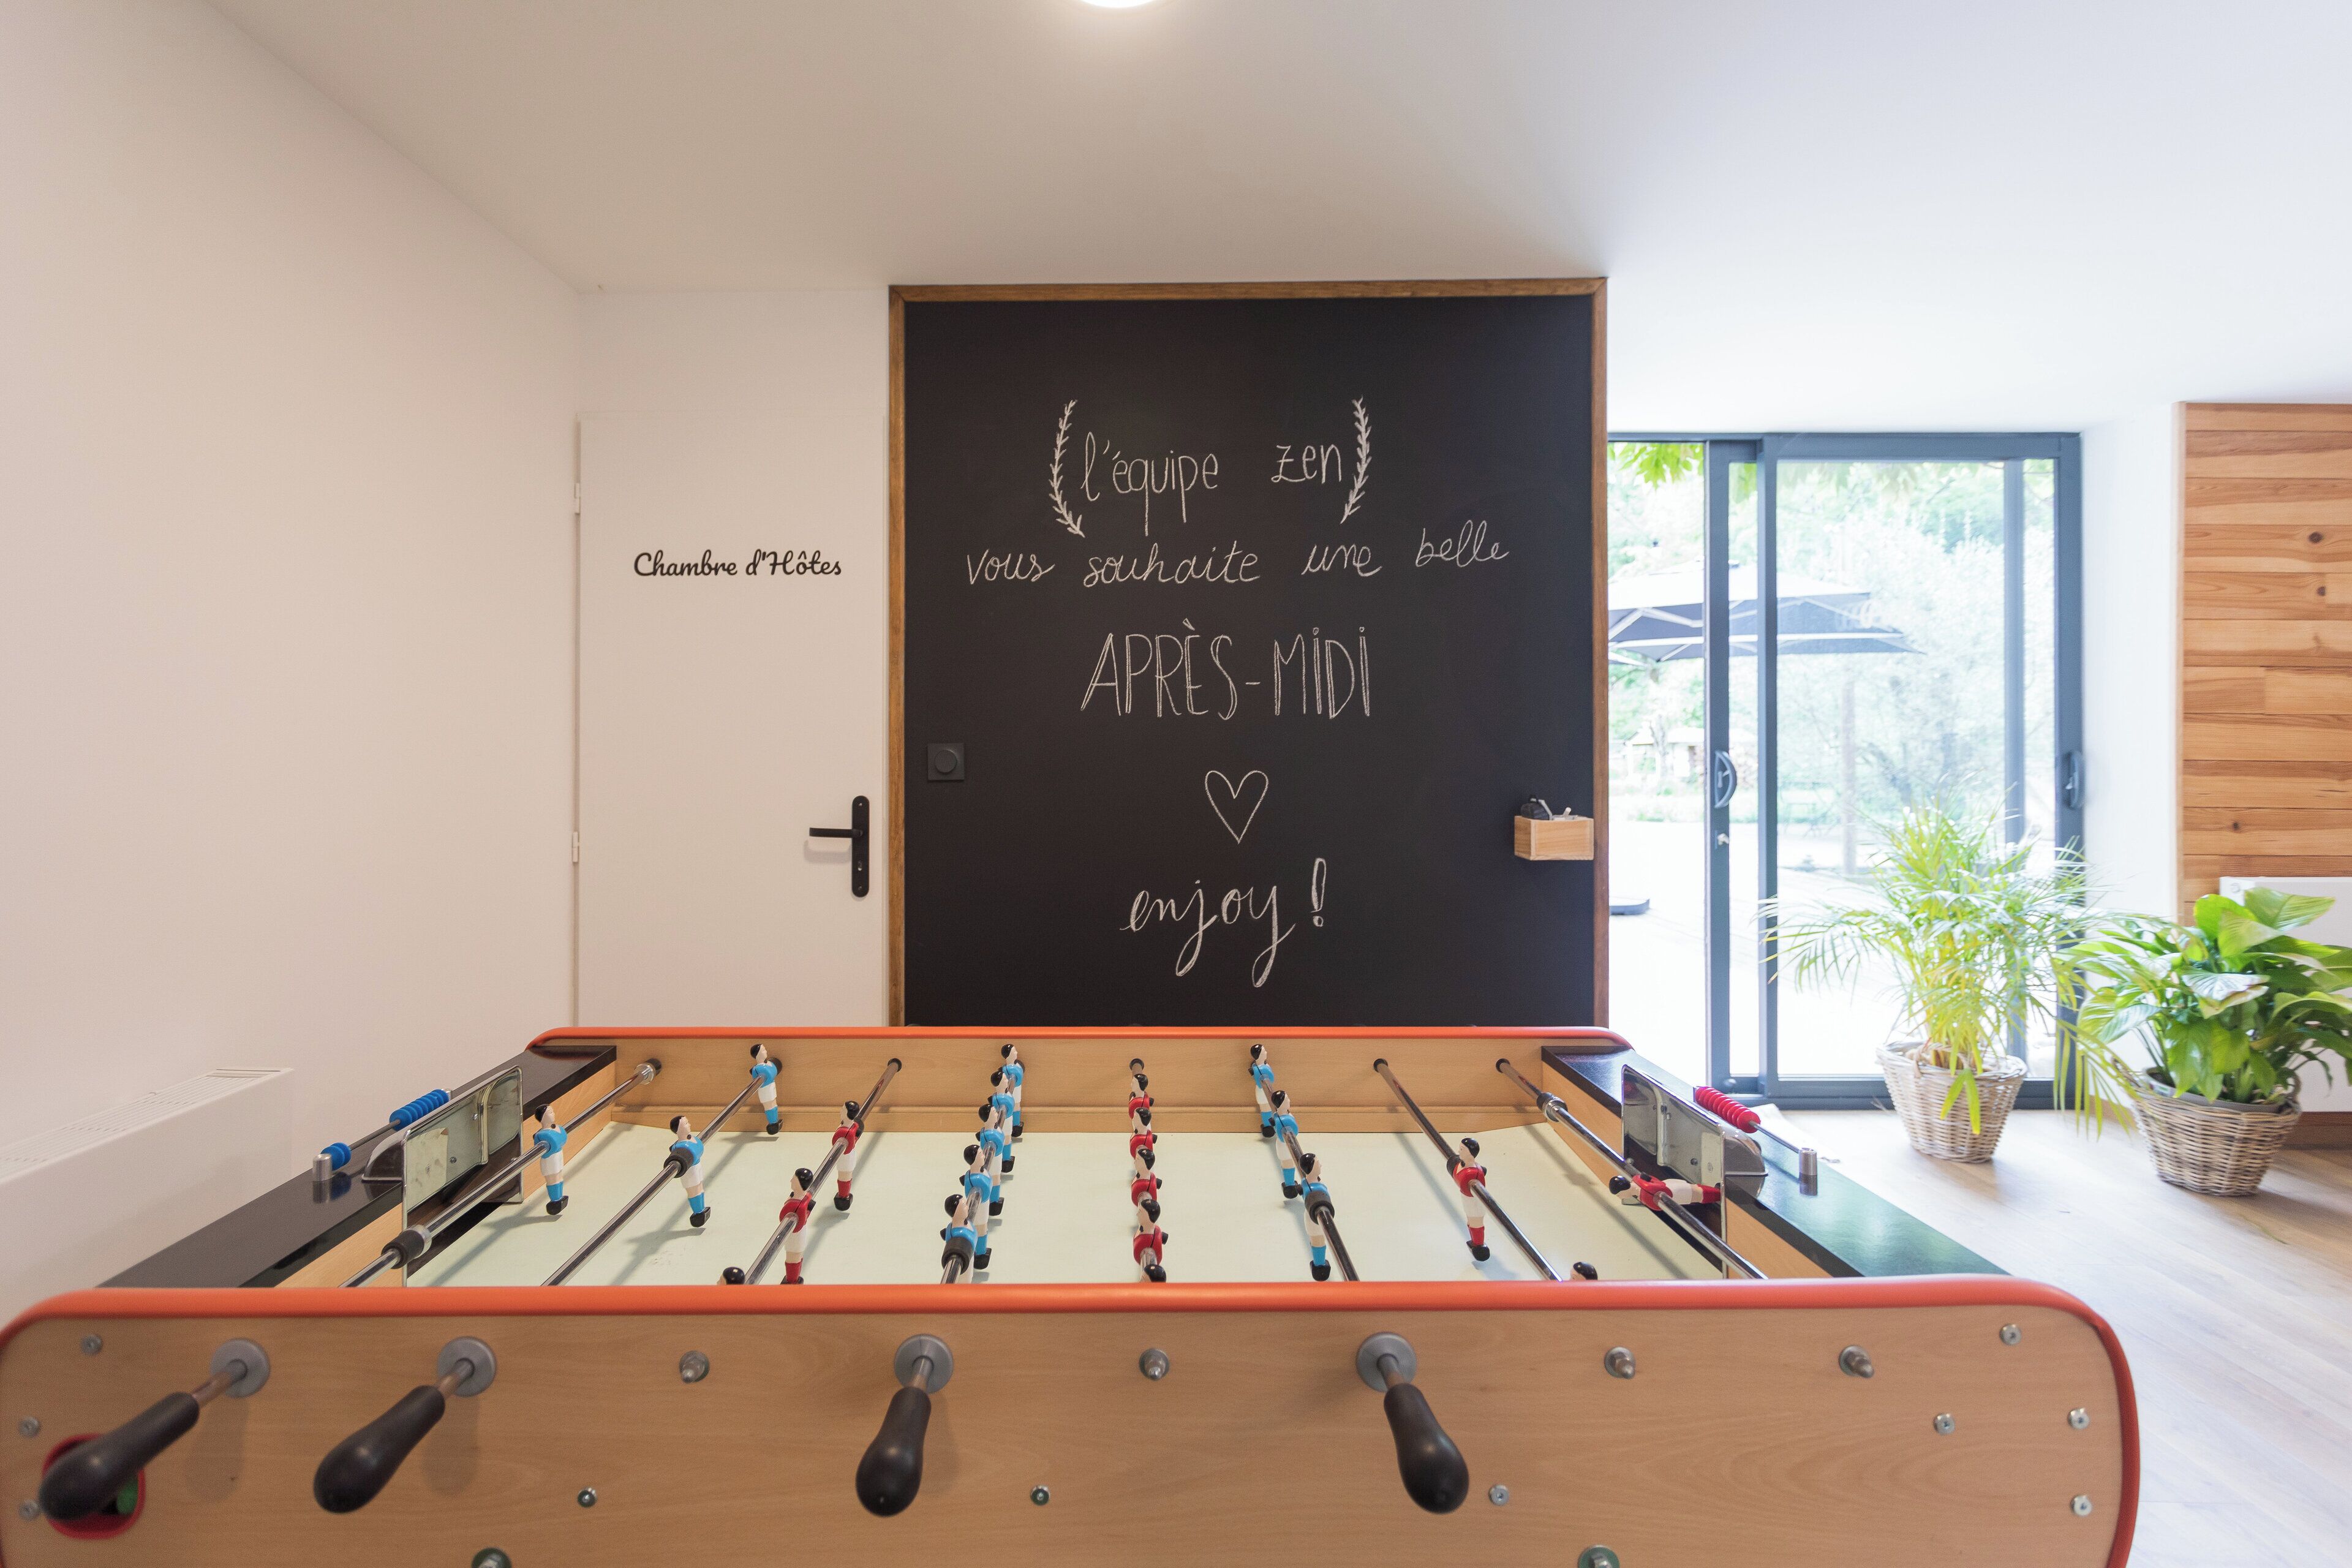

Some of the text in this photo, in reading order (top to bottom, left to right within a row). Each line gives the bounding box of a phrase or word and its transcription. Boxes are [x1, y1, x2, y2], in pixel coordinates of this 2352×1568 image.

[1080, 431, 1343, 537] l'équipe zen
[633, 548, 842, 577] Chambre d'Hôtes
[967, 519, 1510, 588] vous souhaite une belle
